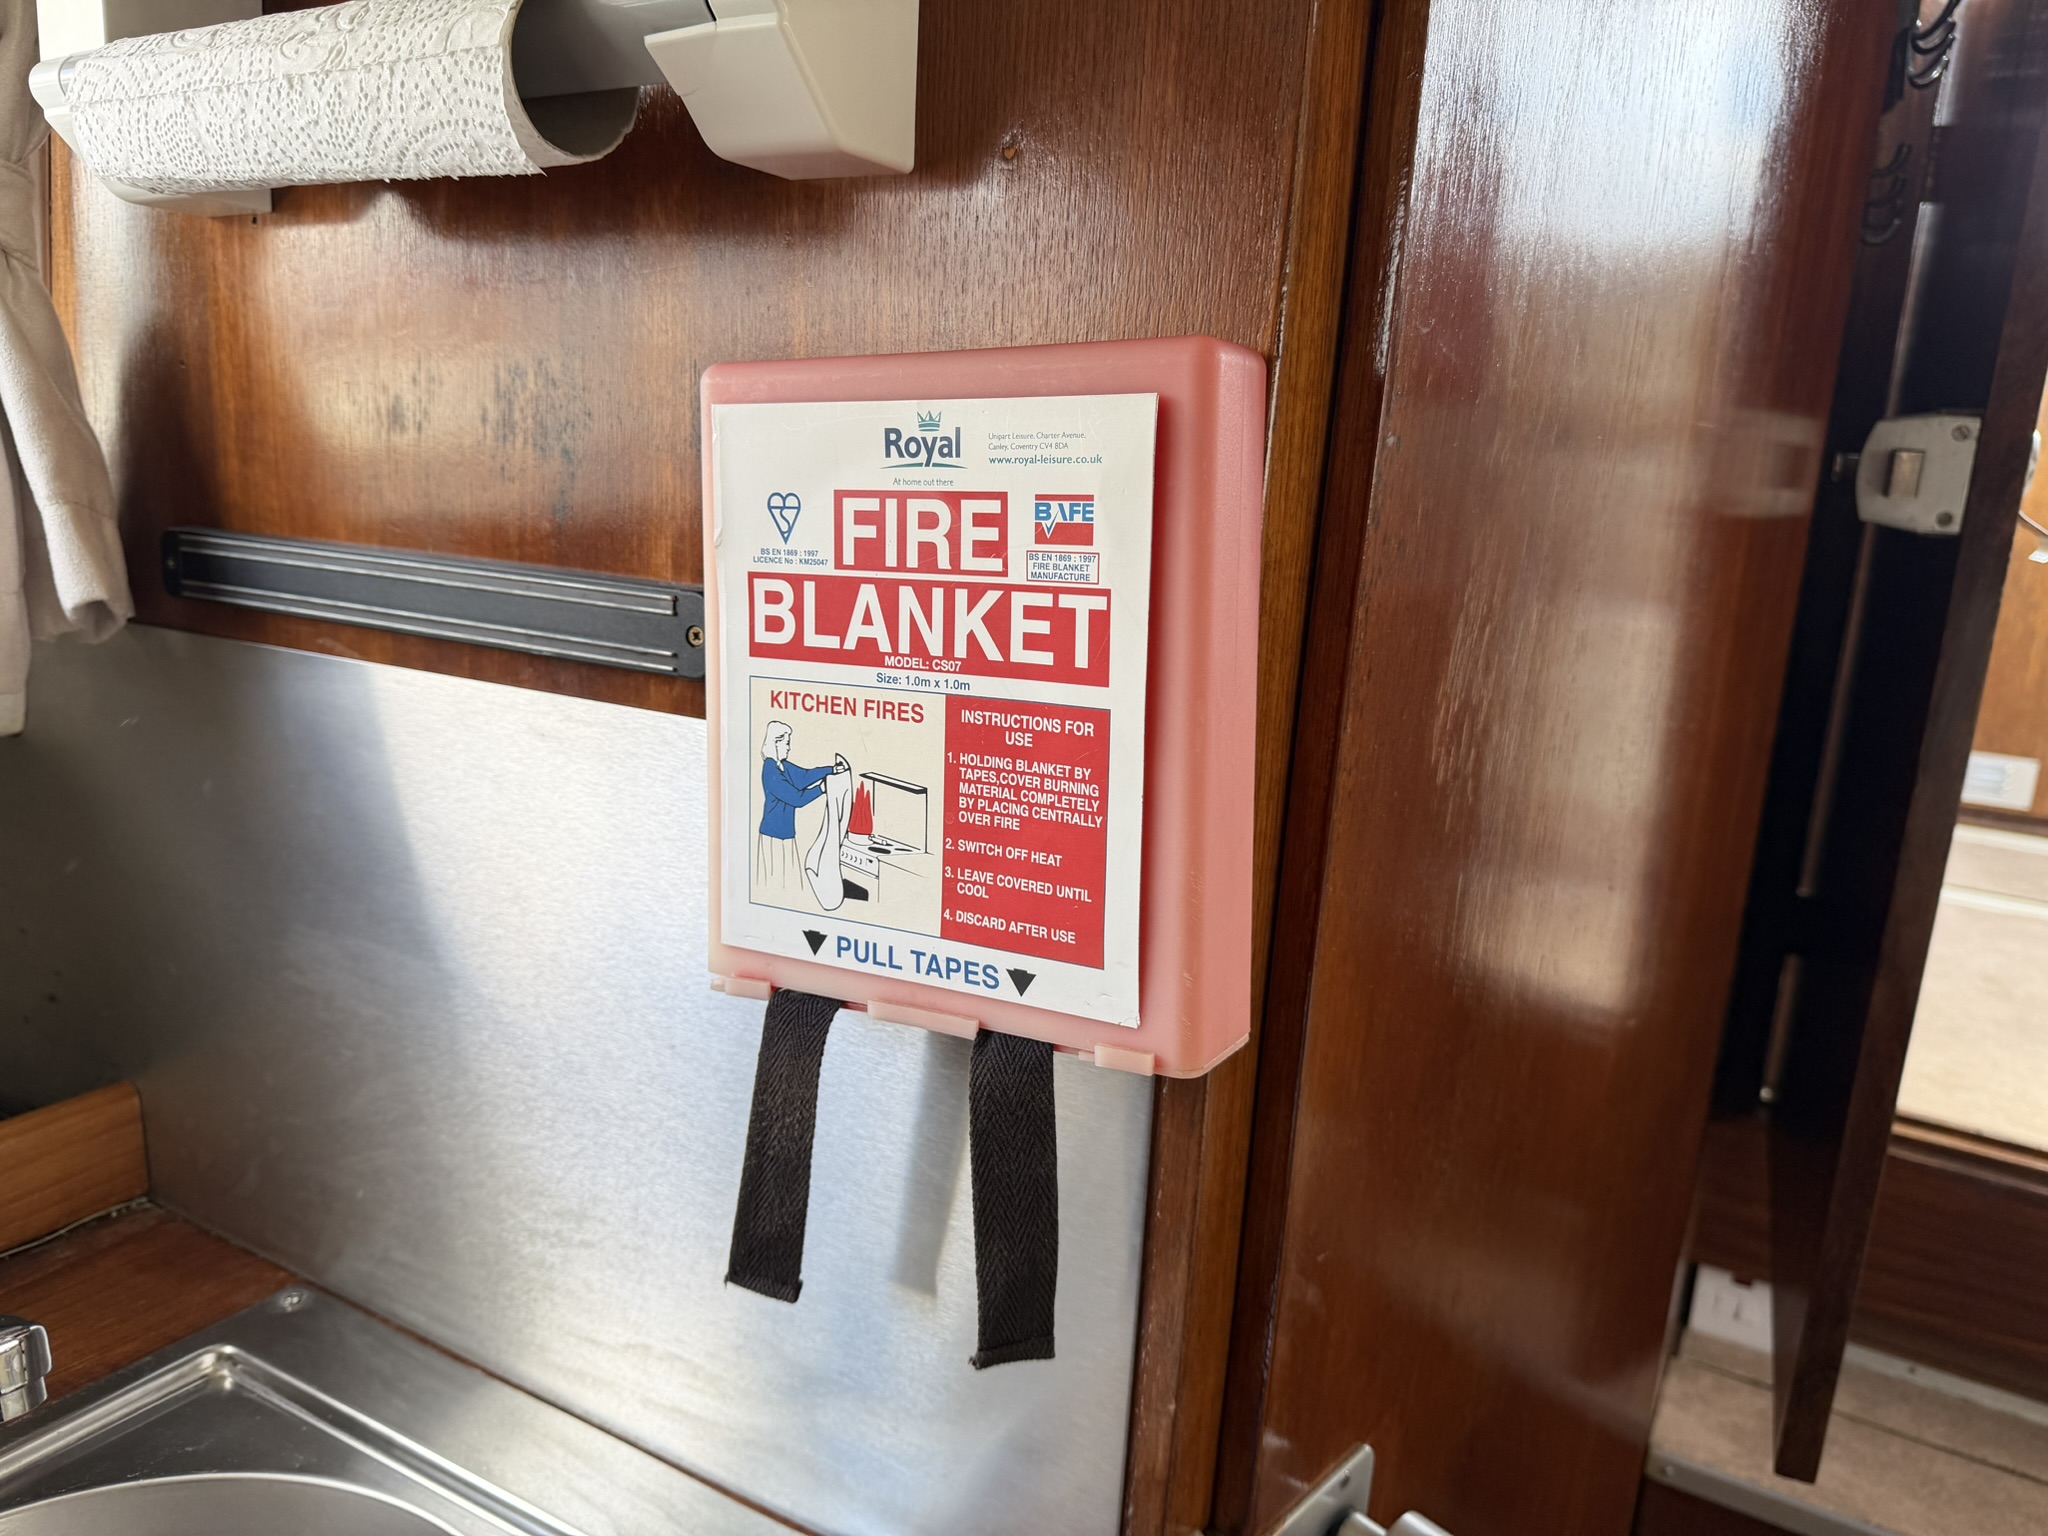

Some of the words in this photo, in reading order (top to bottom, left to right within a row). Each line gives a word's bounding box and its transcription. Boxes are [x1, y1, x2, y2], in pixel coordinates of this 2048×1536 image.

[884, 426, 961, 467] Royal
[988, 433, 1011, 441] Unipart
[1010, 442, 1038, 451] Coventry
[1039, 442, 1053, 450] CV4
[988, 454, 1103, 466] www.royal-leisure.co.uk
[893, 478, 901, 486] At
[902, 478, 922, 486] home
[936, 478, 954, 486] there
[842, 497, 1003, 572] FIRE
[753, 556, 783, 564] LICENCE
[760, 547, 771, 555] BS
[772, 548, 782, 556] EN
[803, 549, 819, 557] 1997
[1028, 553, 1039, 561] BS
[1041, 553, 1052, 561] EN
[1054, 554, 1072, 562] 1869
[1078, 555, 1096, 563] 1997
[1030, 571, 1091, 581] MANUFACTURE
[1032, 562, 1051, 570] FIRE
[1052, 563, 1090, 572] BLANKET
[753, 577, 1109, 669] BLANKET
[884, 655, 929, 670] MODEL:
[932, 659, 962, 672] CS07
[876, 672, 902, 685] Size:
[905, 675, 931, 687] 1.0m
[934, 680, 941, 688] x
[944, 678, 970, 691] 1.0m
[770, 689, 857, 717] KITCHEN
[863, 698, 924, 724] FIRES
[961, 709, 1061, 734] INSTRUCTIONS
[1064, 720, 1095, 737] FOR
[1005, 730, 1033, 747] USE
[947, 751, 956, 764] 1.
[959, 752, 1012, 771] HOLDING
[1015, 759, 1071, 778] BLANKET
[1074, 767, 1091, 781] BY
[959, 781, 1018, 801] MATERIAL
[1020, 789, 1100, 813] COMPLETELY
[1043, 778, 1099, 797] BURNING
[958, 810, 991, 827] OVER
[993, 815, 1020, 831] FIRE
[959, 796, 974, 810] BY
[977, 798, 1029, 817] PLACING
[1032, 806, 1103, 829] CENTRALLY
[945, 837, 955, 850] 2.
[957, 839, 1002, 857] SWITCH
[1005, 846, 1028, 861] OFF
[1031, 851, 1062, 867] HEAT
[944, 866, 954, 878] 3.
[957, 867, 994, 885] LEAVE
[996, 874, 1053, 896] COVERED
[1056, 884, 1092, 903] UNTIL
[956, 882, 989, 899] COOL
[943, 908, 953, 921] 4.
[955, 910, 1006, 931] DISCARD
[1008, 920, 1048, 939] AFTER
[1051, 928, 1076, 944] USE
[836, 935, 903, 970] PULL
[910, 949, 1000, 990] TAPES
